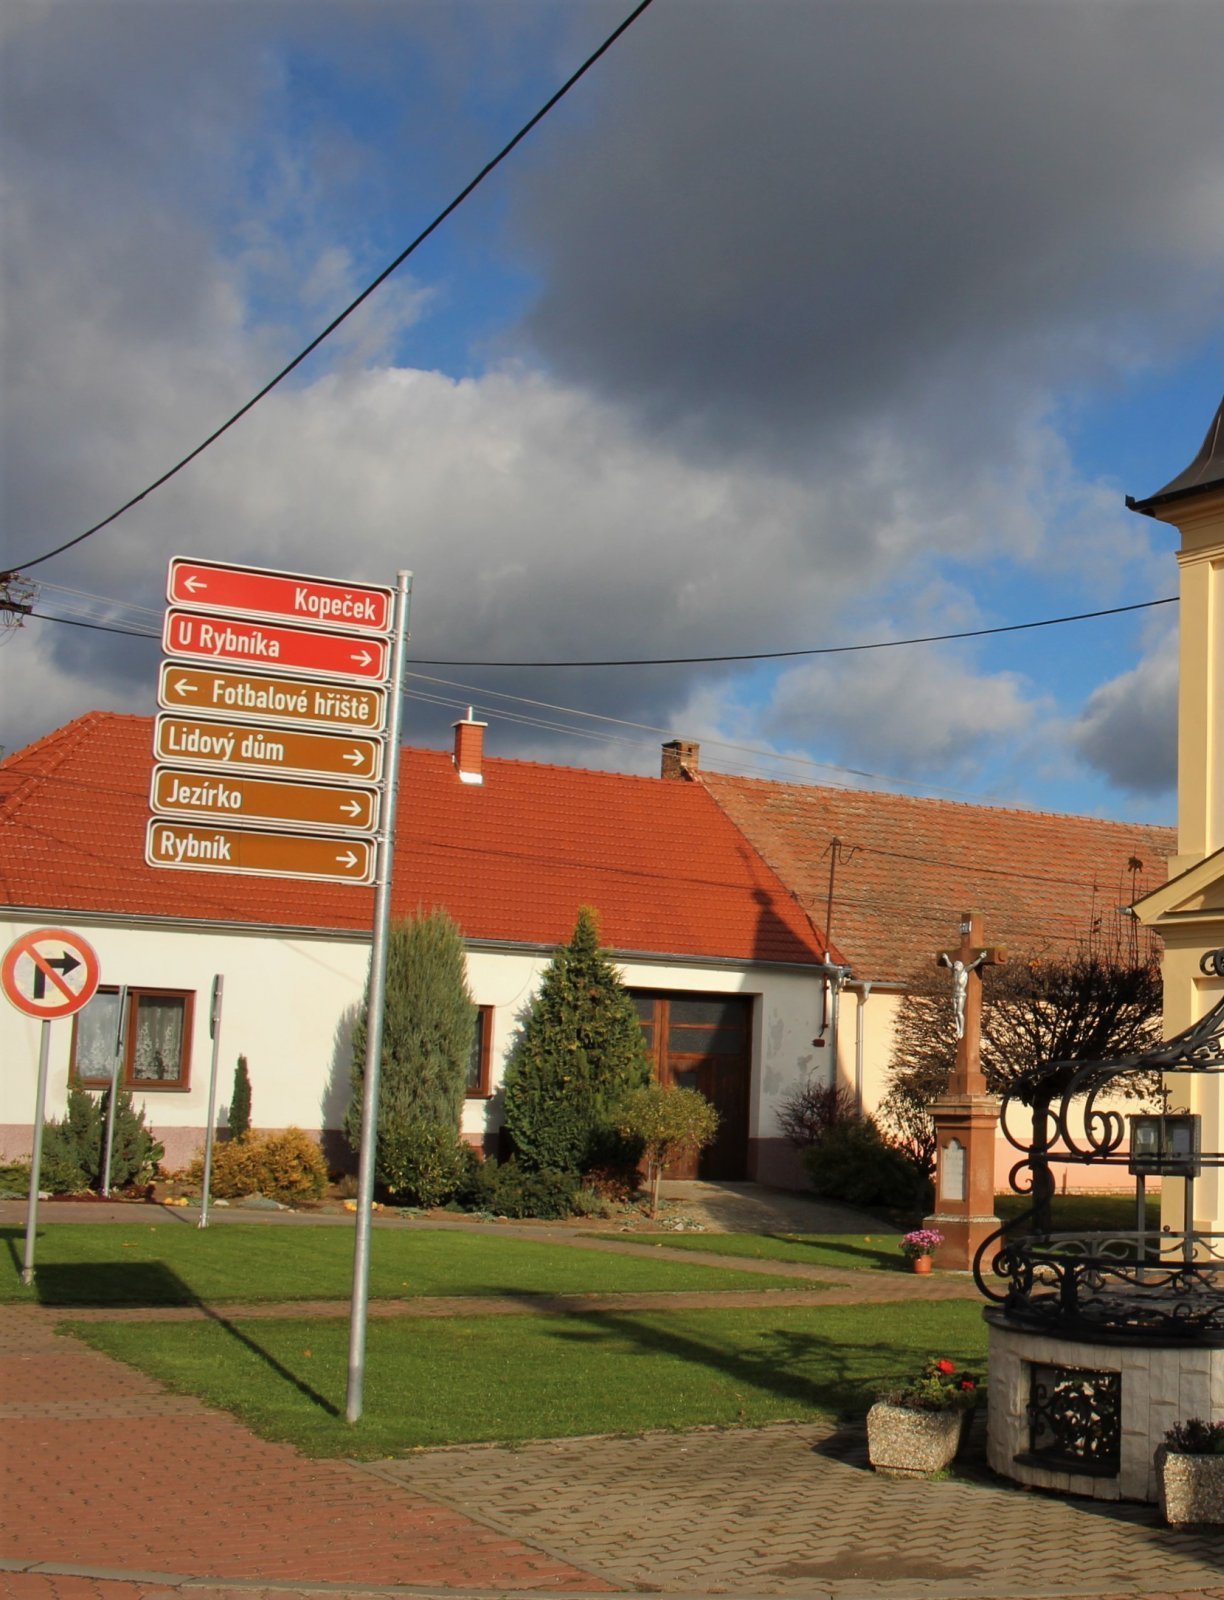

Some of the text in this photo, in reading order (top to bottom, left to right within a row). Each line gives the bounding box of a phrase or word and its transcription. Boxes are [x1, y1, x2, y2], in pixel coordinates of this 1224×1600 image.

[294, 587, 376, 621] Kopeček
[178, 621, 280, 658] U Rybníka
[212, 680, 369, 720] Fotbalové hřiště
[168, 726, 284, 761] Lidový dům
[166, 779, 242, 809] Jezírko
[160, 831, 231, 862] Rybník
